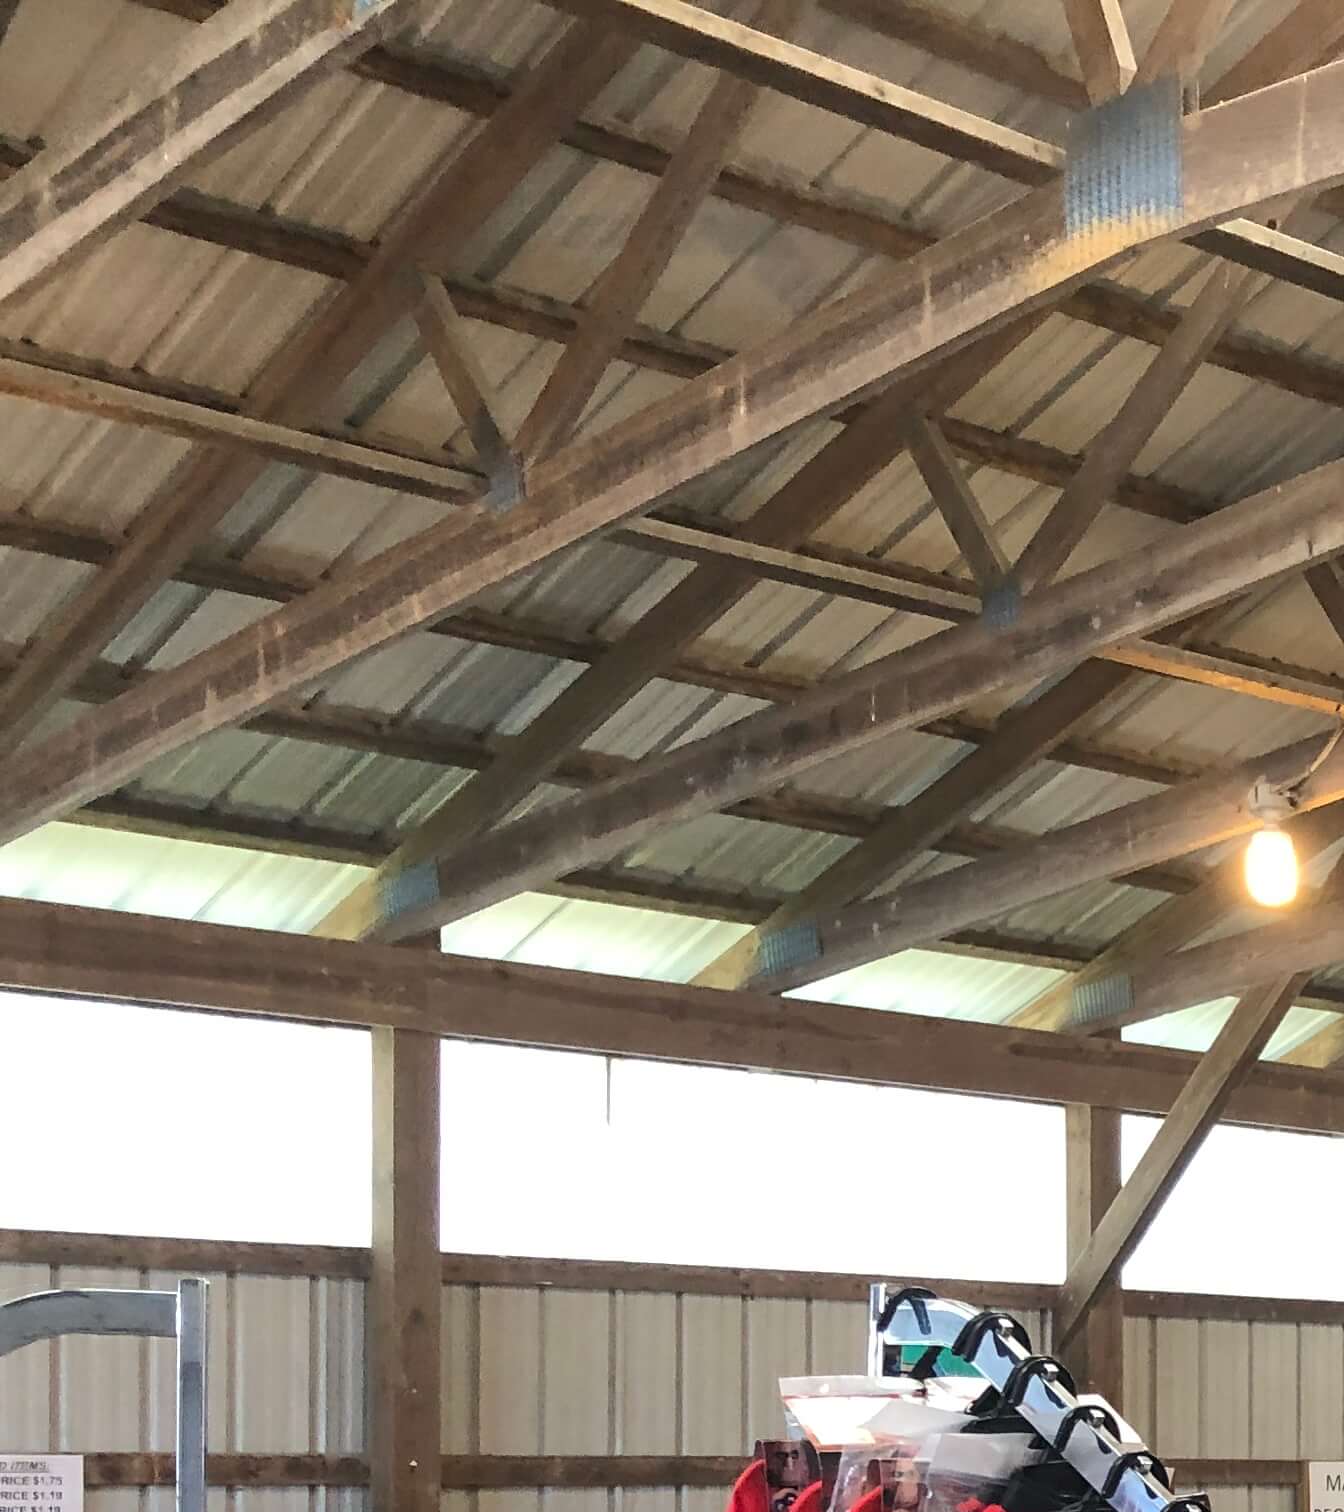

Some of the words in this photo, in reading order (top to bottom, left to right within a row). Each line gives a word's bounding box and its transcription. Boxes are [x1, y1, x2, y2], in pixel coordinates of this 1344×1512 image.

[1, 1476, 30, 1486] RICE
[33, 1476, 62, 1486] $1.75
[0, 1491, 28, 1500] RICE
